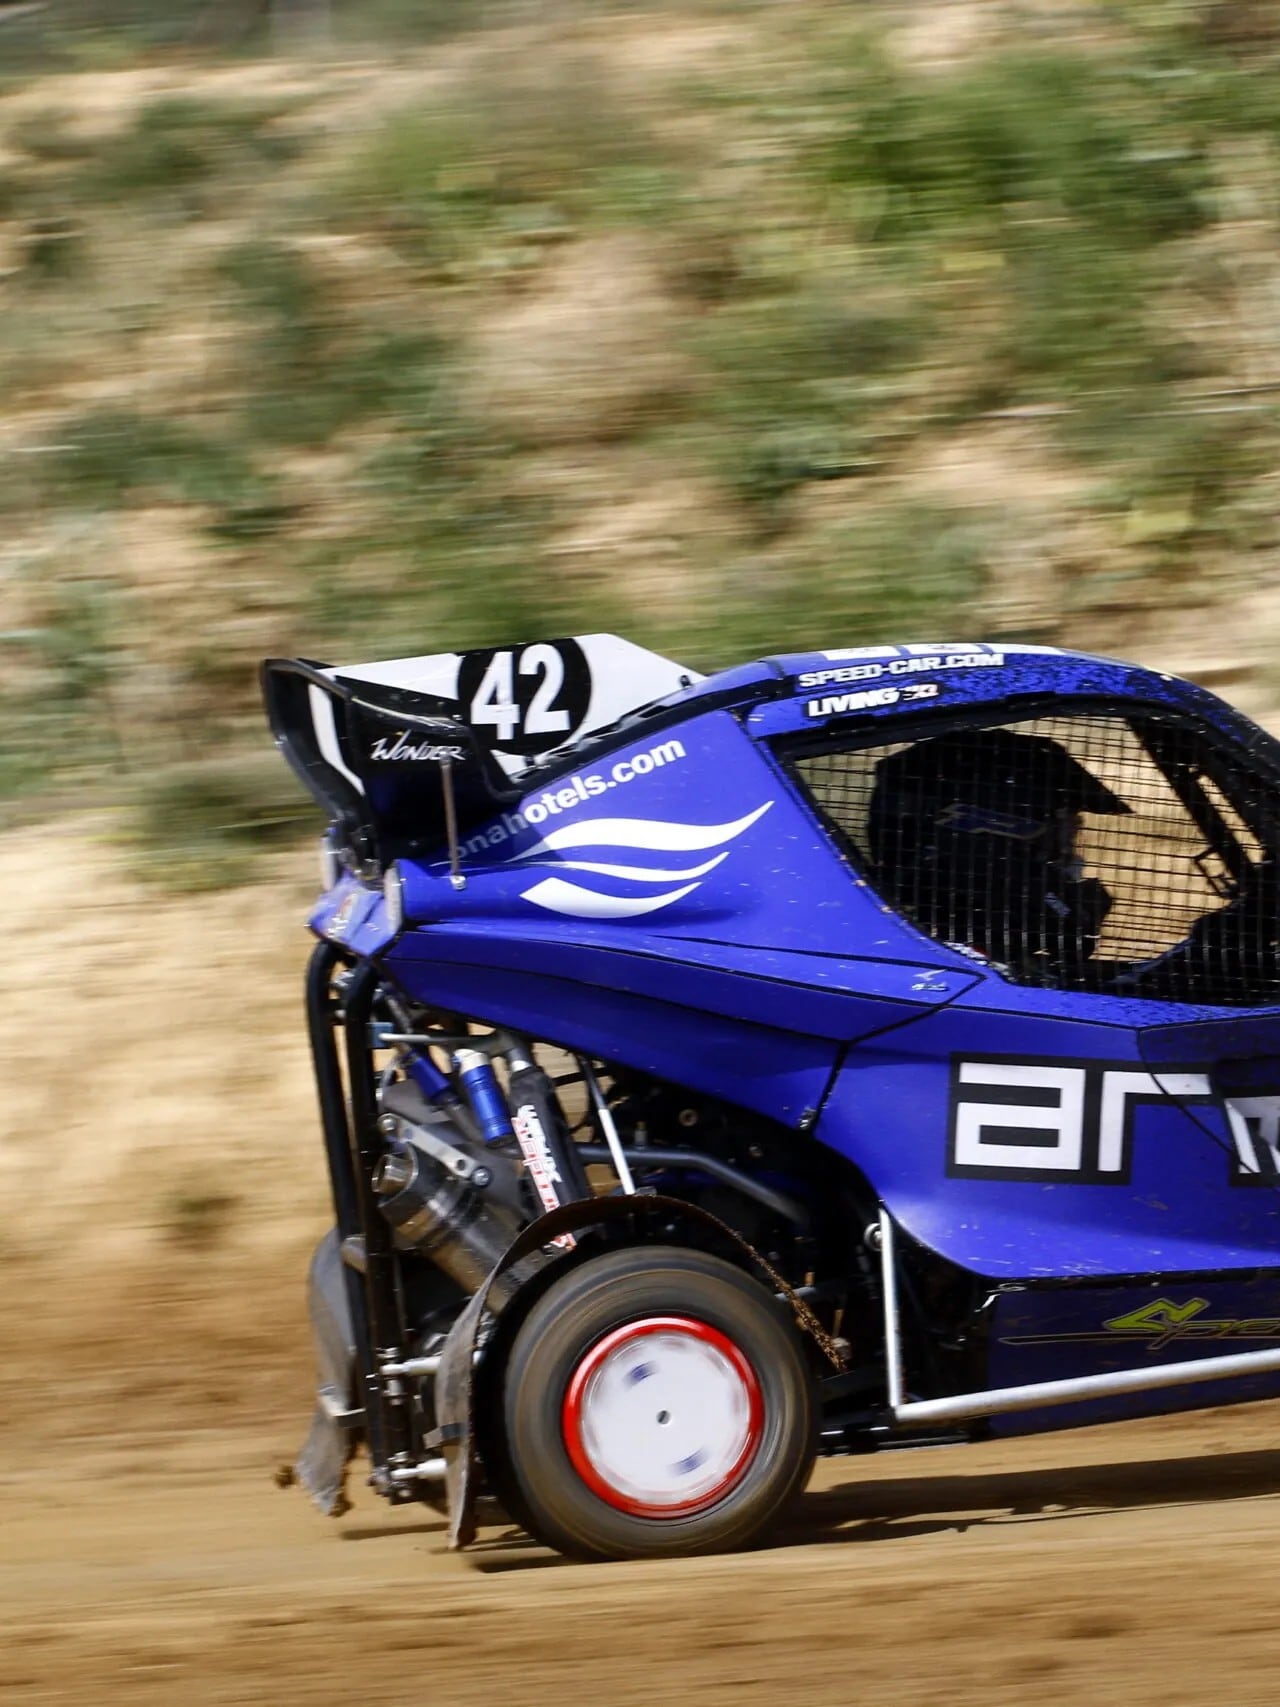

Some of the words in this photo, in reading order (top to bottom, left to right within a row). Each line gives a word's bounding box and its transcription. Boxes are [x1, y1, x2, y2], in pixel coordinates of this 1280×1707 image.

[799, 655, 1004, 687] SPEED-CAR.COM
[470, 643, 571, 741] 42
[808, 687, 900, 716] LIVING
